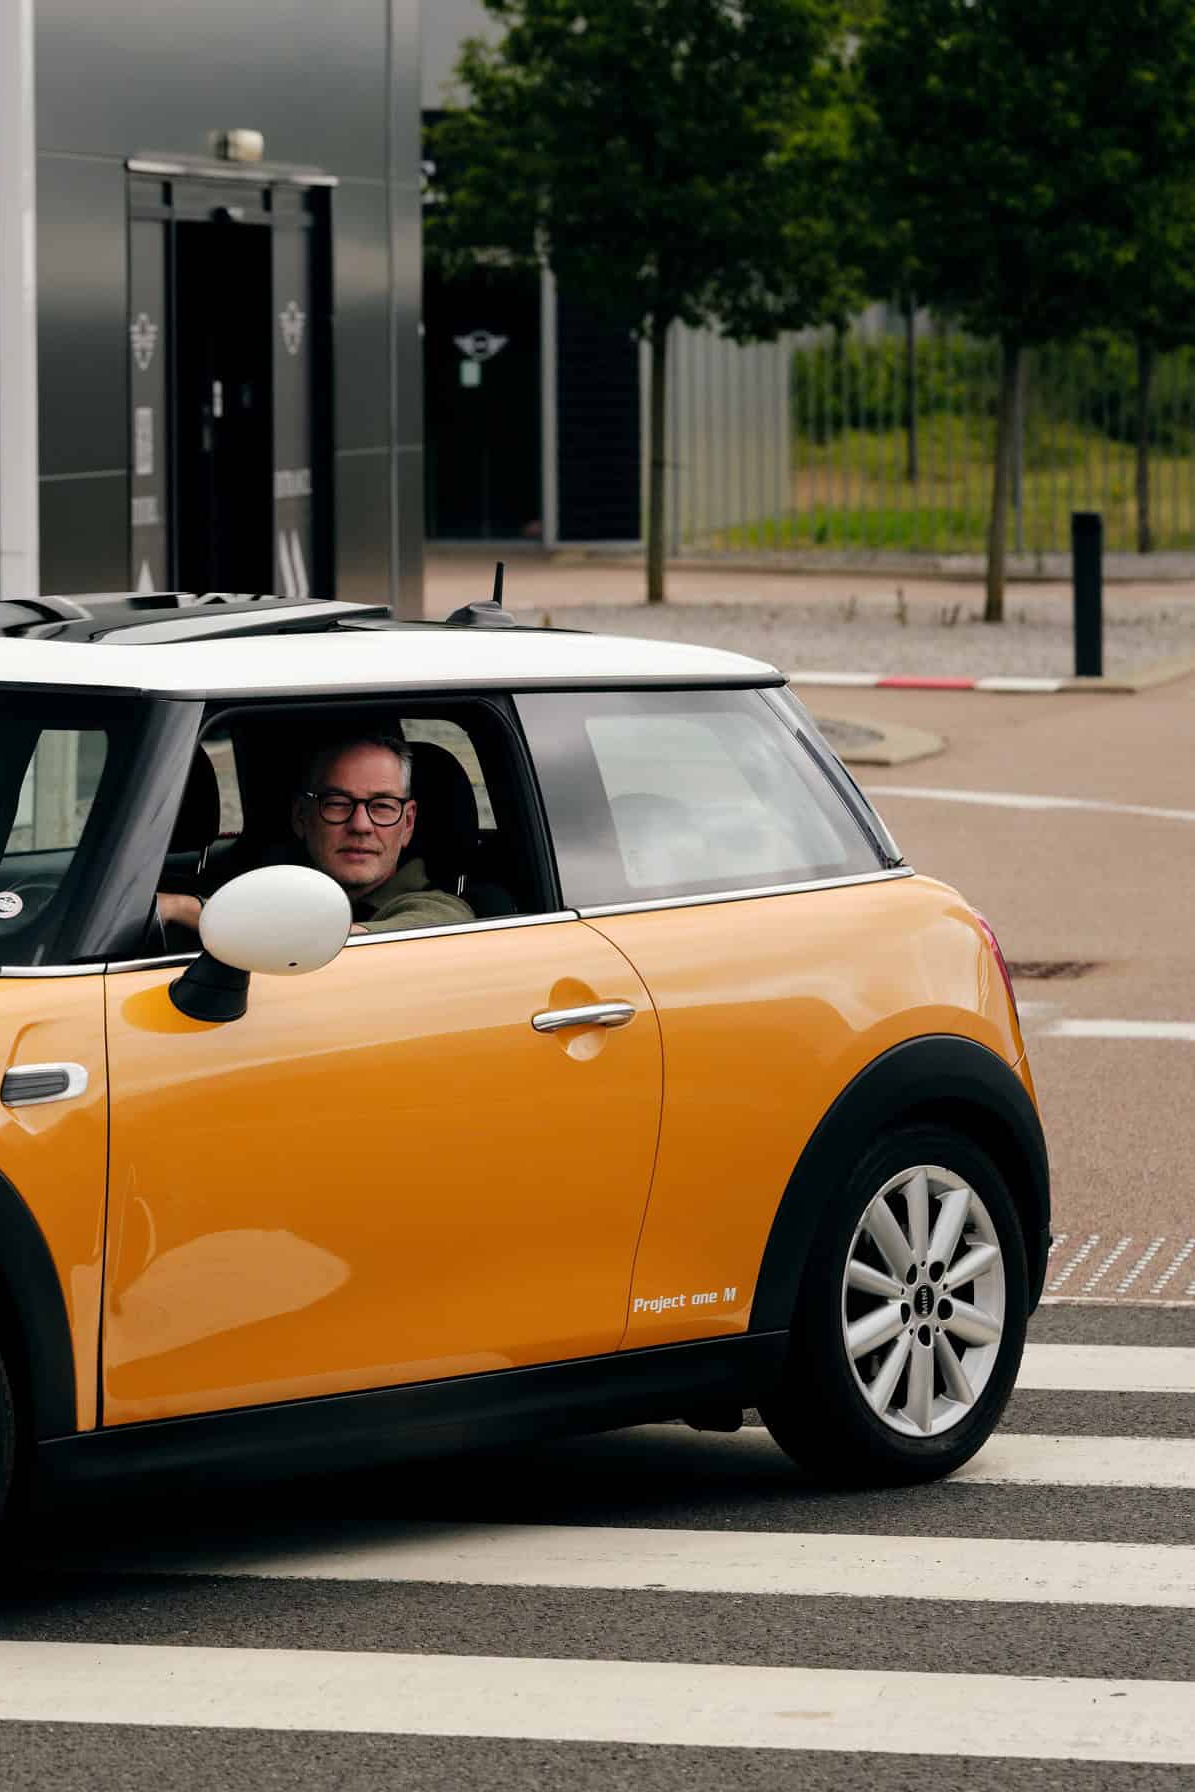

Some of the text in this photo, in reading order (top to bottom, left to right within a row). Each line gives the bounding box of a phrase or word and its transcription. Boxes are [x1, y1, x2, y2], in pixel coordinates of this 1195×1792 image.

[633, 1287, 737, 1313] Project one M
[921, 1288, 929, 1314] MINI
